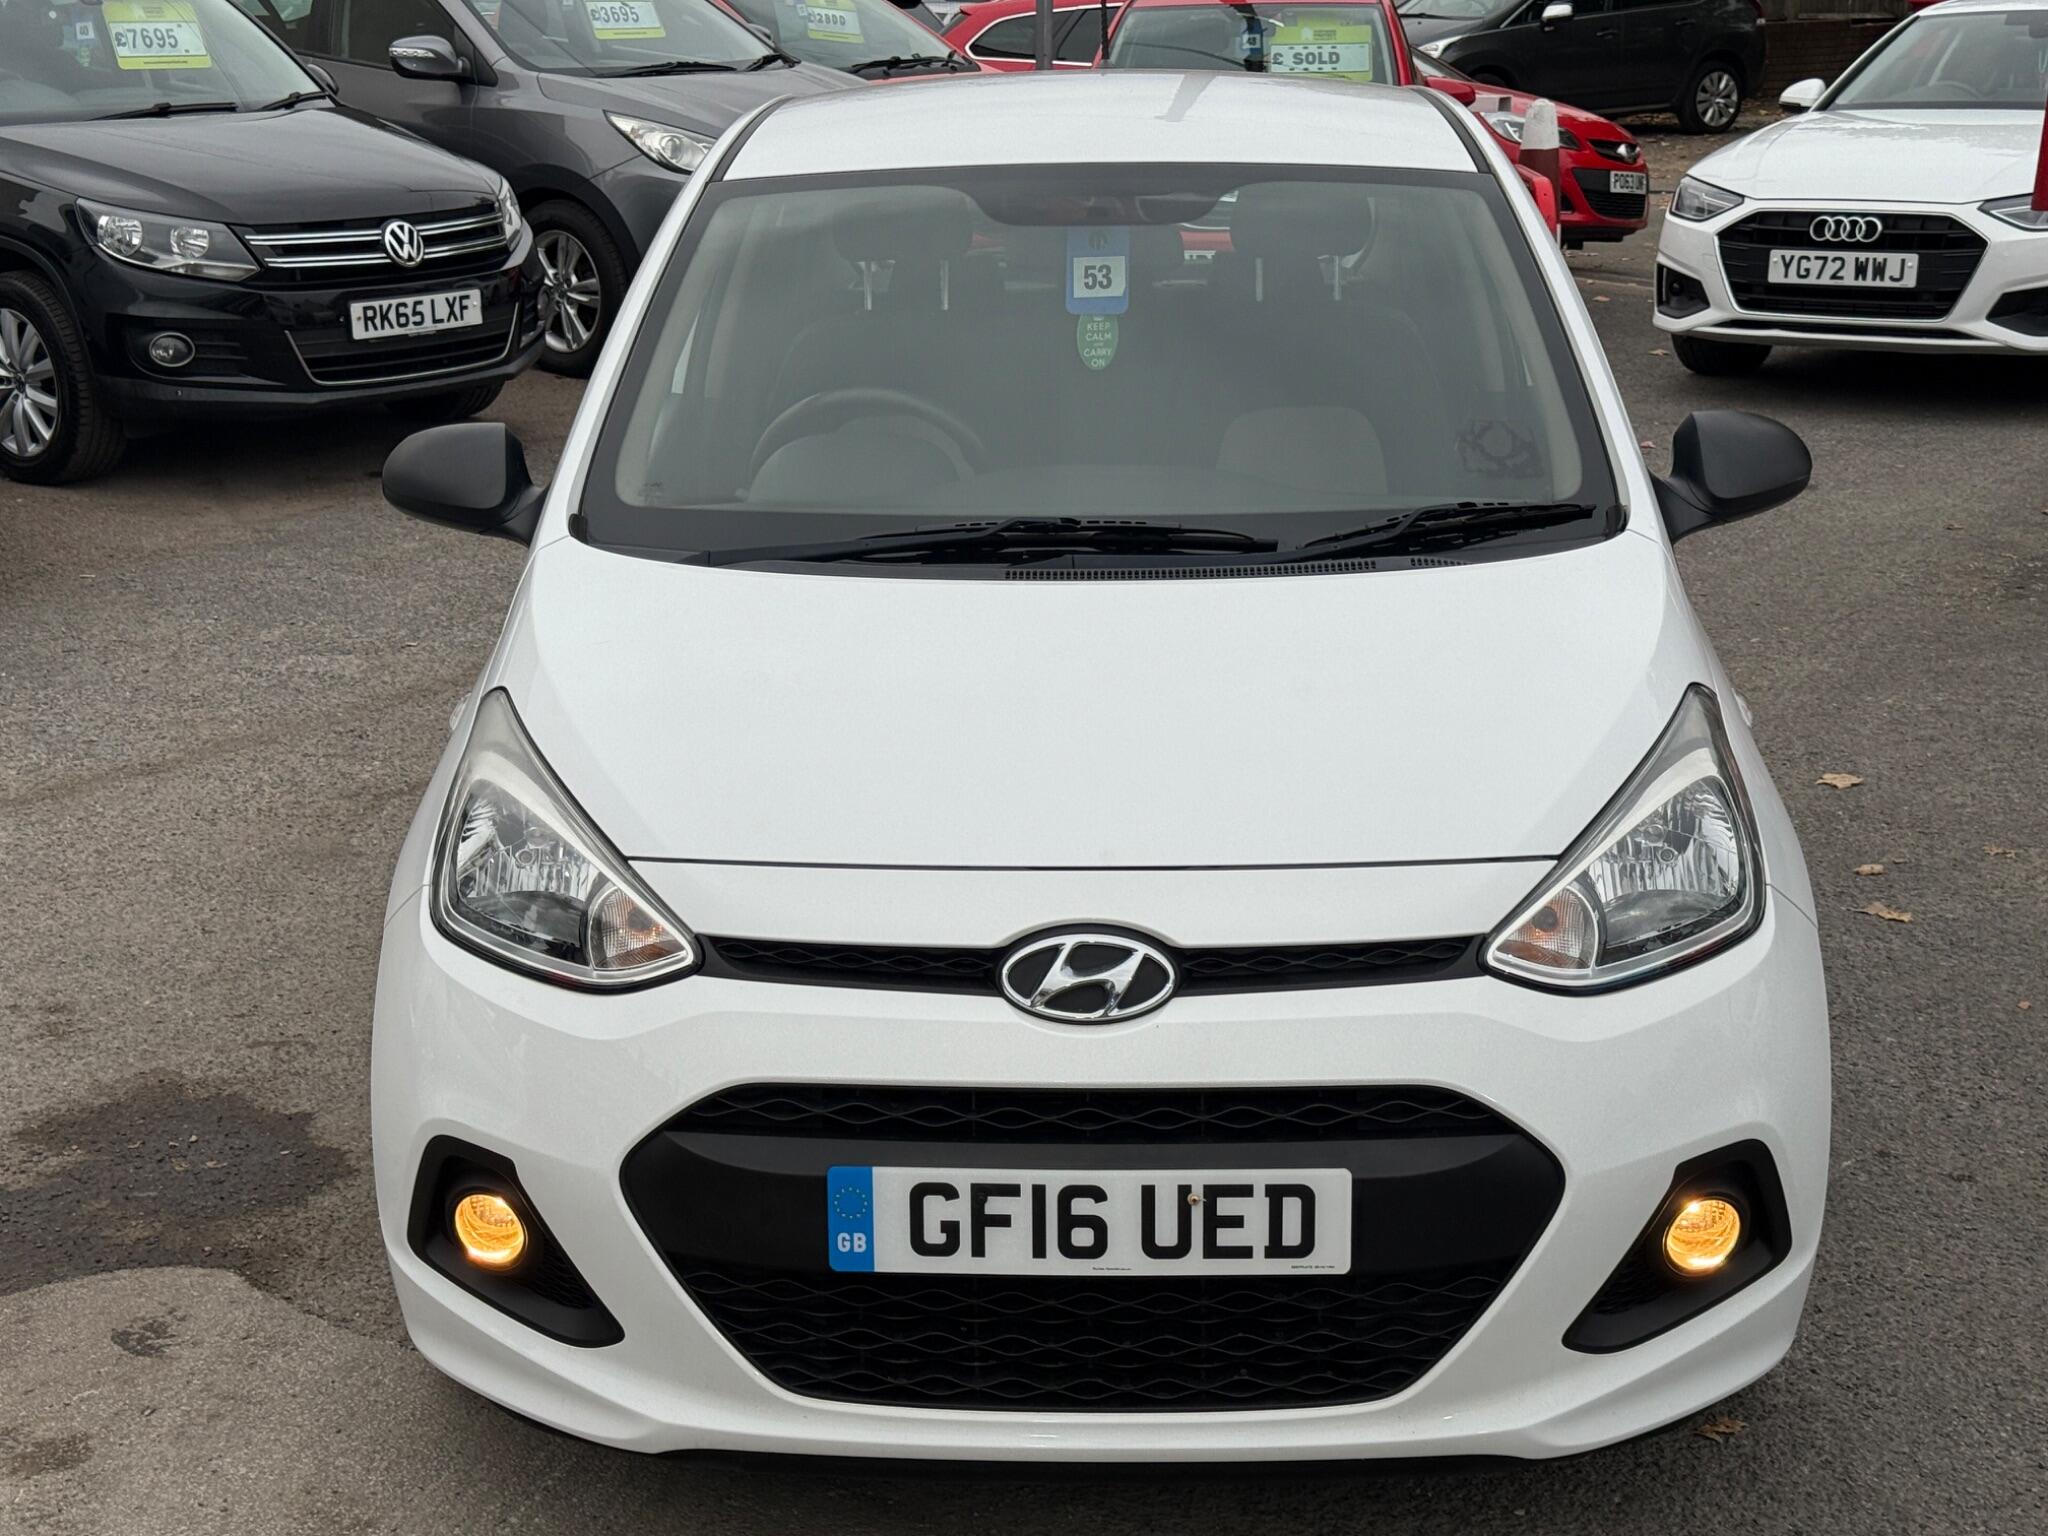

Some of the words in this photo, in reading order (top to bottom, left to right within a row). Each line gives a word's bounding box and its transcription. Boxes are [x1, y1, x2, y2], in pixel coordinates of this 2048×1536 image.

[590, 6, 640, 23] £3695
[114, 28, 179, 49] £7695
[1292, 52, 1341, 65] SOLD
[1083, 264, 1113, 290] 53
[1780, 254, 1846, 281] YG72
[1853, 256, 1907, 283] WWJ
[362, 301, 425, 332] RK65
[431, 295, 471, 325] LXF
[1087, 322, 1111, 331] KEEP
[1085, 332, 1112, 341] CALM
[1083, 348, 1112, 357] CARRY
[1091, 358, 1105, 367] ON
[909, 1182, 1108, 1259] GF16
[1141, 1184, 1316, 1259] UED
[837, 1232, 867, 1253] GB
